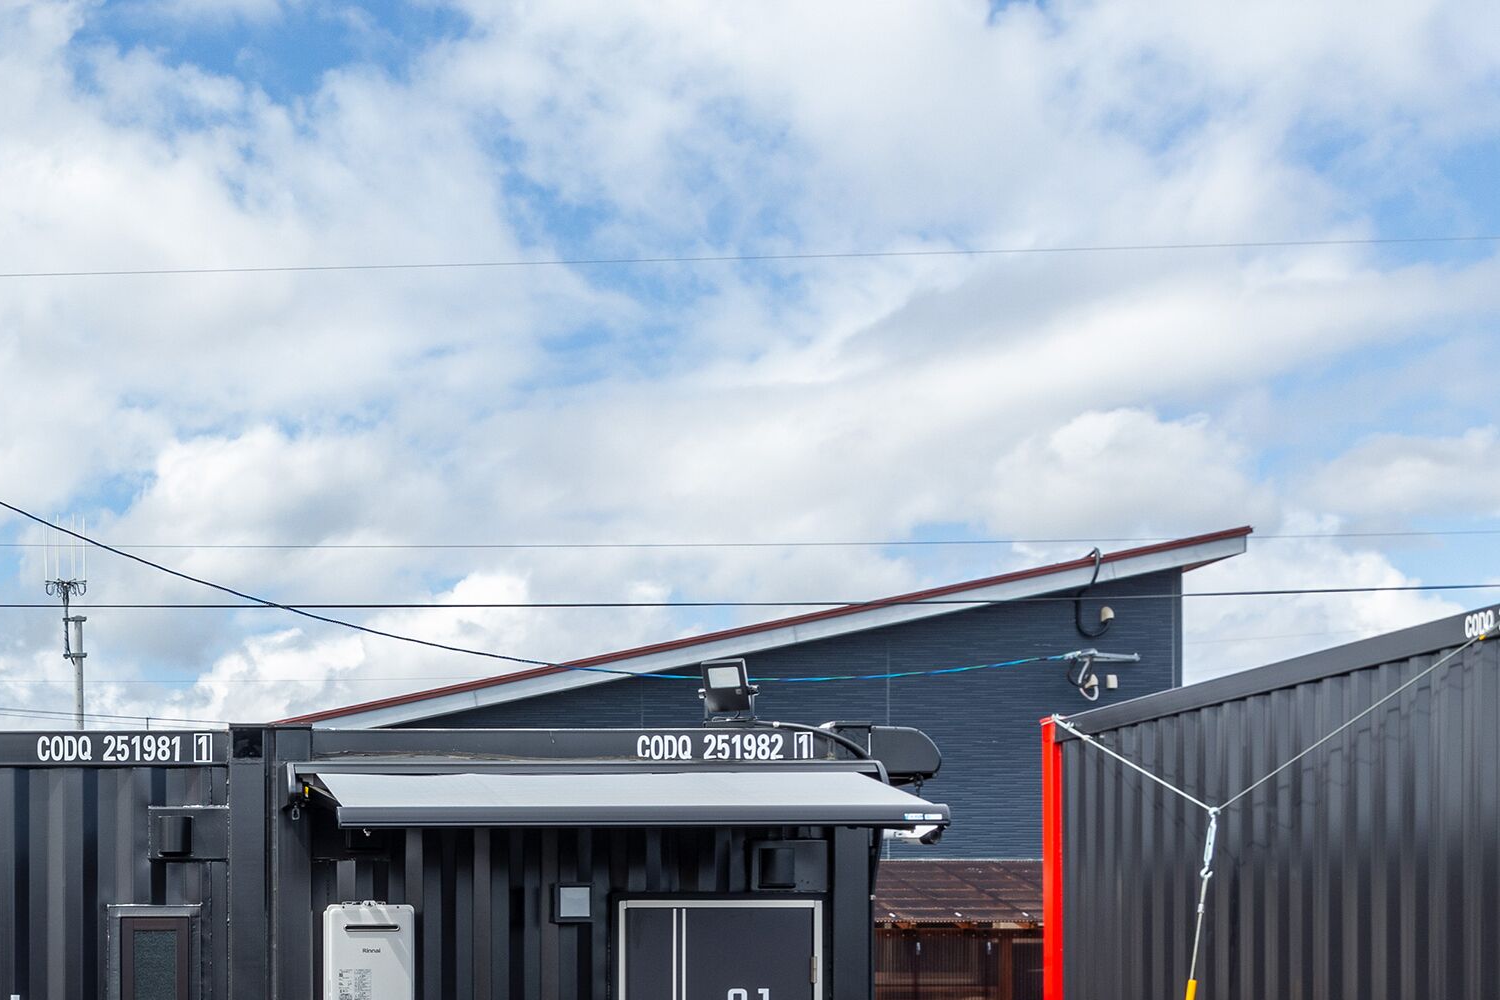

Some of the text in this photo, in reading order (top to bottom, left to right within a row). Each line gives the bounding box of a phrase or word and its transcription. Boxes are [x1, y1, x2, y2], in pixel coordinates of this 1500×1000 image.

[37, 734, 209, 762] CODQ 251981 1
[637, 734, 810, 760] CODQ 251982 1
